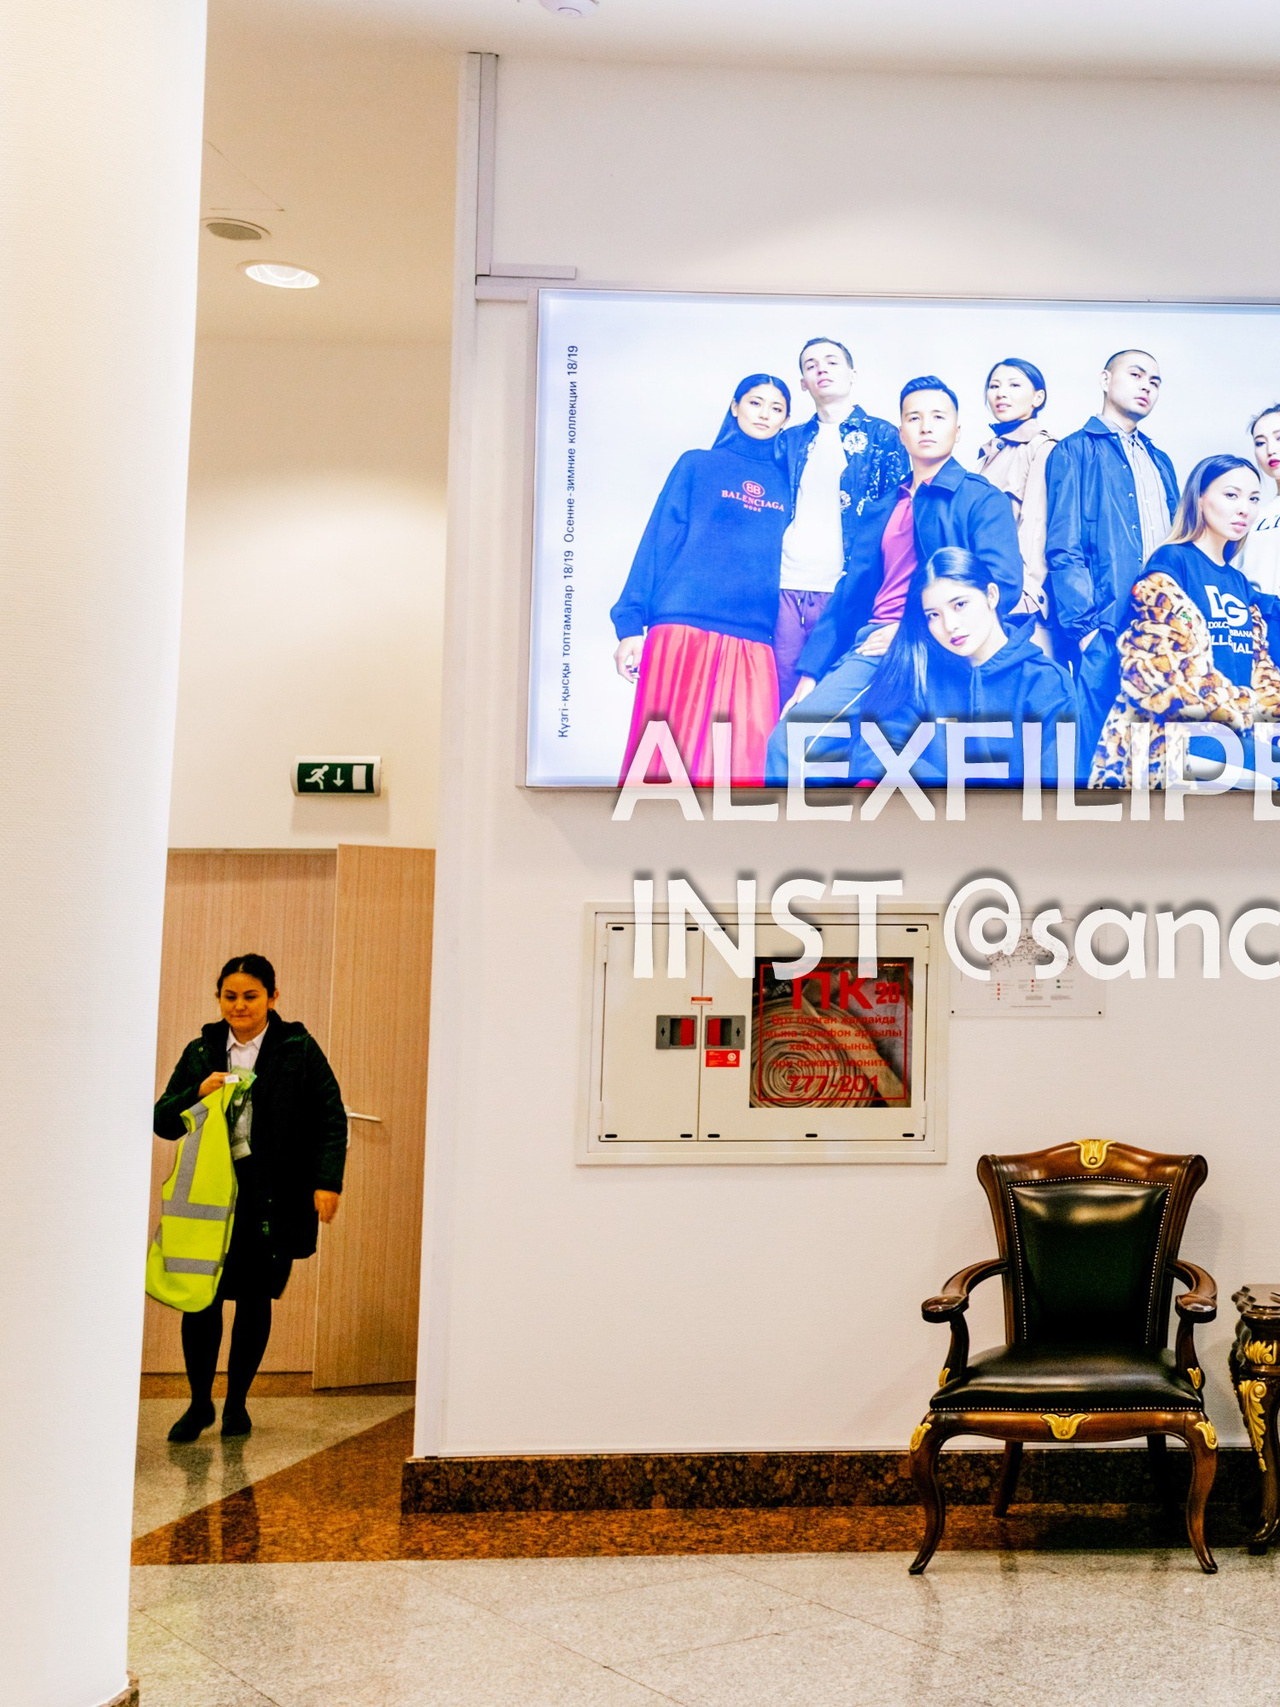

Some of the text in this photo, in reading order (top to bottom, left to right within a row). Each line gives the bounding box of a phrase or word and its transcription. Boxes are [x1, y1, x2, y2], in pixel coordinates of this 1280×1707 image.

[567, 345, 579, 376] 18/19
[568, 381, 578, 444] коллекции
[721, 489, 785, 512] BALENCIAGA
[563, 550, 574, 580] 18/19
[562, 585, 575, 657] топтамалар
[791, 970, 901, 1010] ПК 20
[787, 1074, 879, 1094] 777-201
